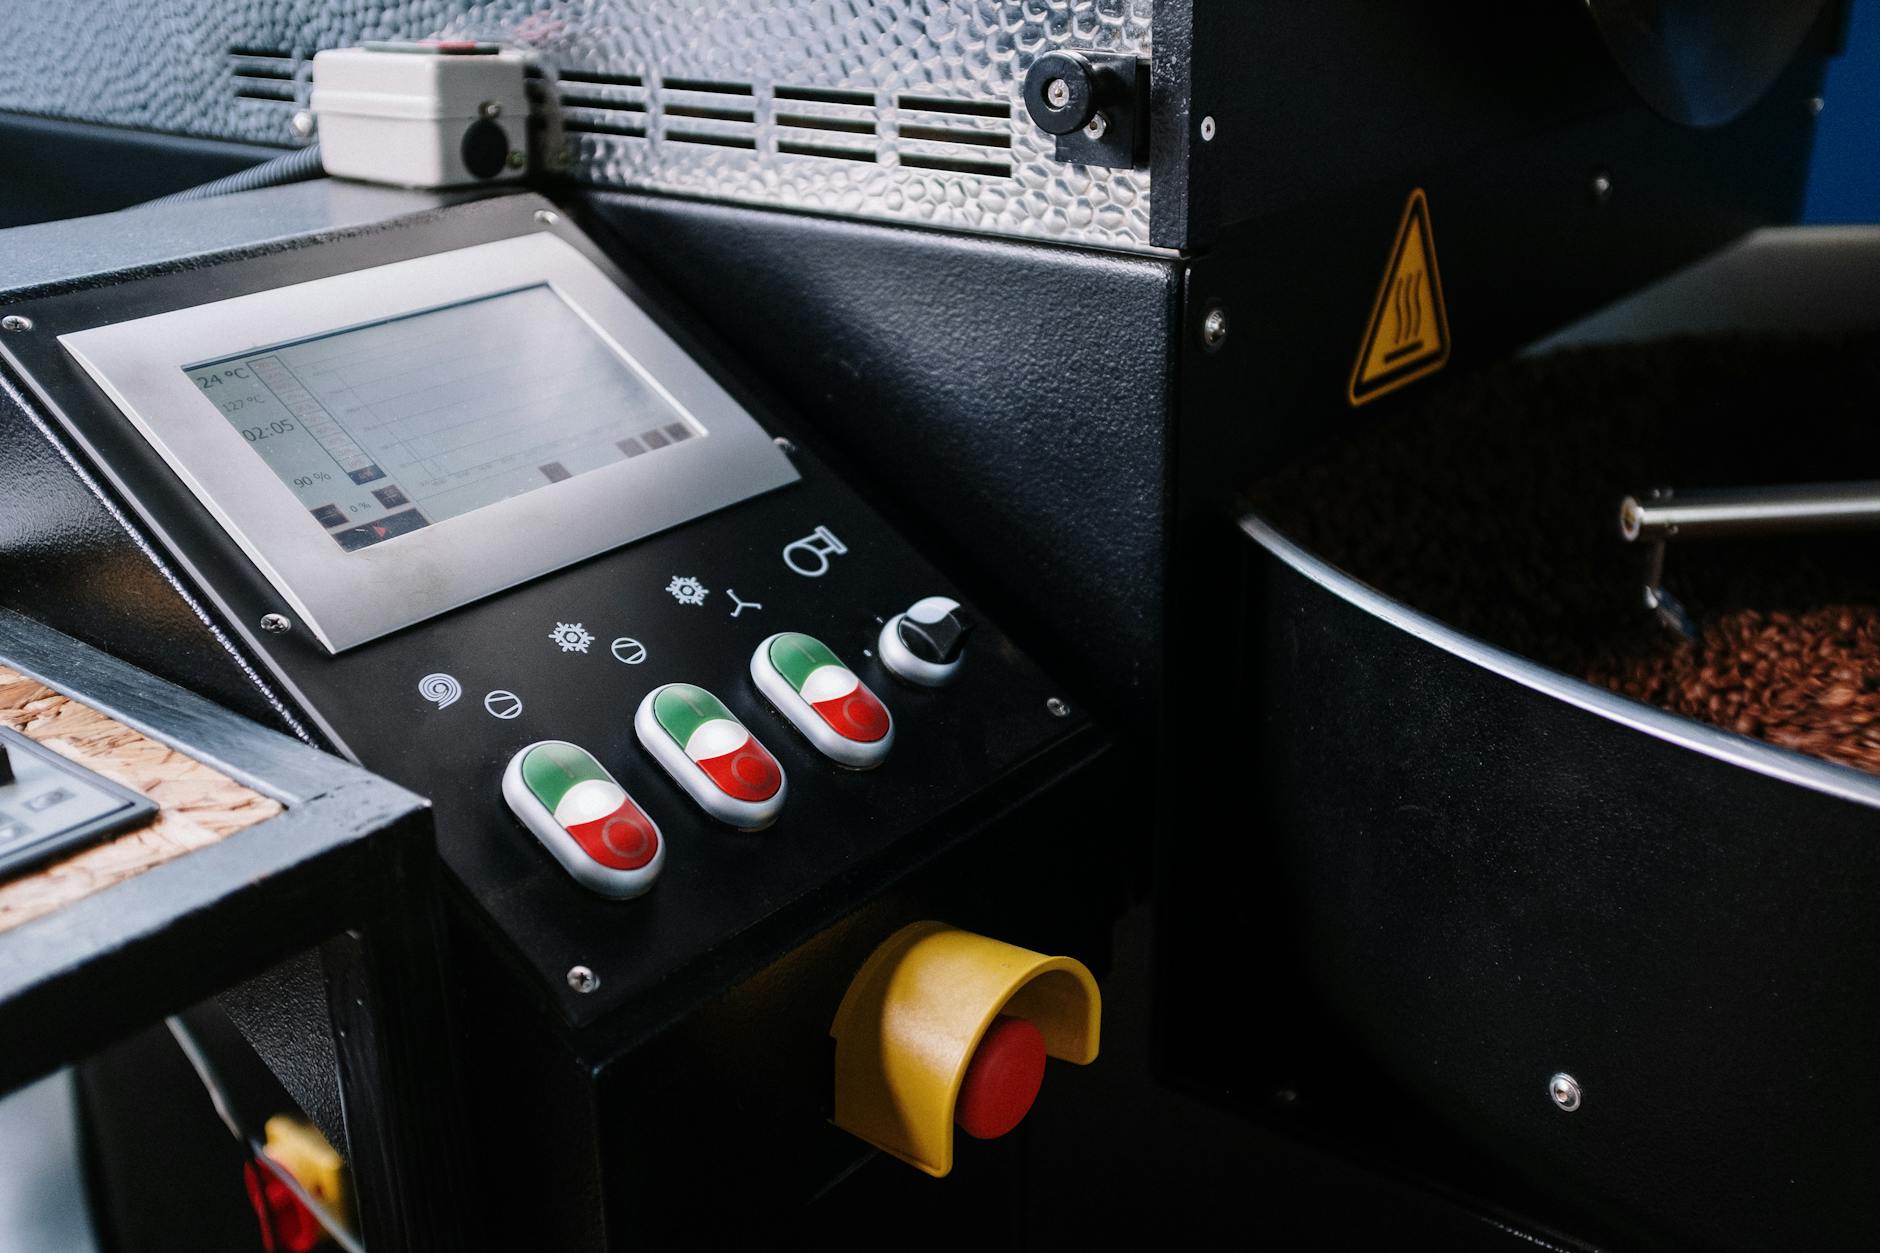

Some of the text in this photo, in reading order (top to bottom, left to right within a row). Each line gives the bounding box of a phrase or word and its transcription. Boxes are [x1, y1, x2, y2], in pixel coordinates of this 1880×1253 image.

[196, 373, 224, 389] 24
[242, 418, 295, 442] 02:05
[293, 470, 332, 489] 90 %
